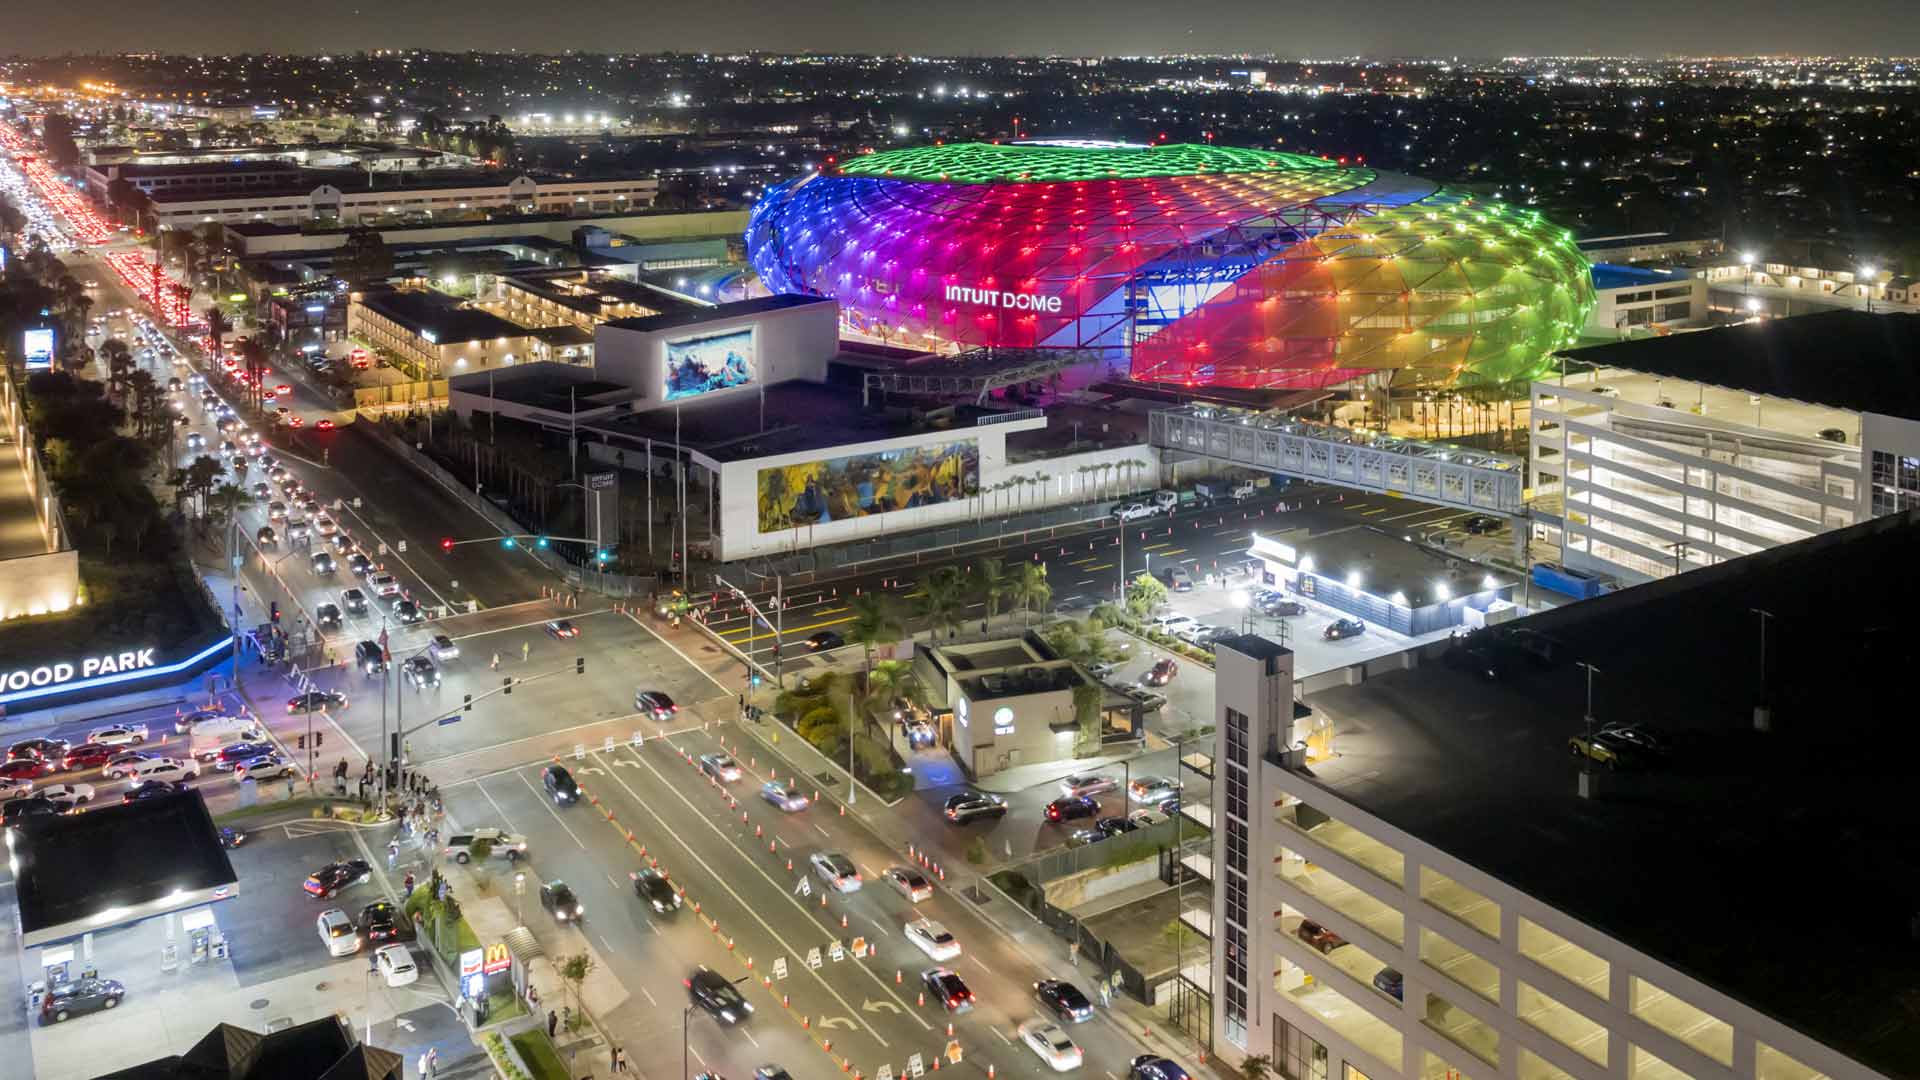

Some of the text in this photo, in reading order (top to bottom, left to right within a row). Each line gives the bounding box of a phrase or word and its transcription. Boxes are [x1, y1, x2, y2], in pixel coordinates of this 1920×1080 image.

[945, 285, 1061, 312] INTUIT DOME
[82, 648, 155, 678] PARK
